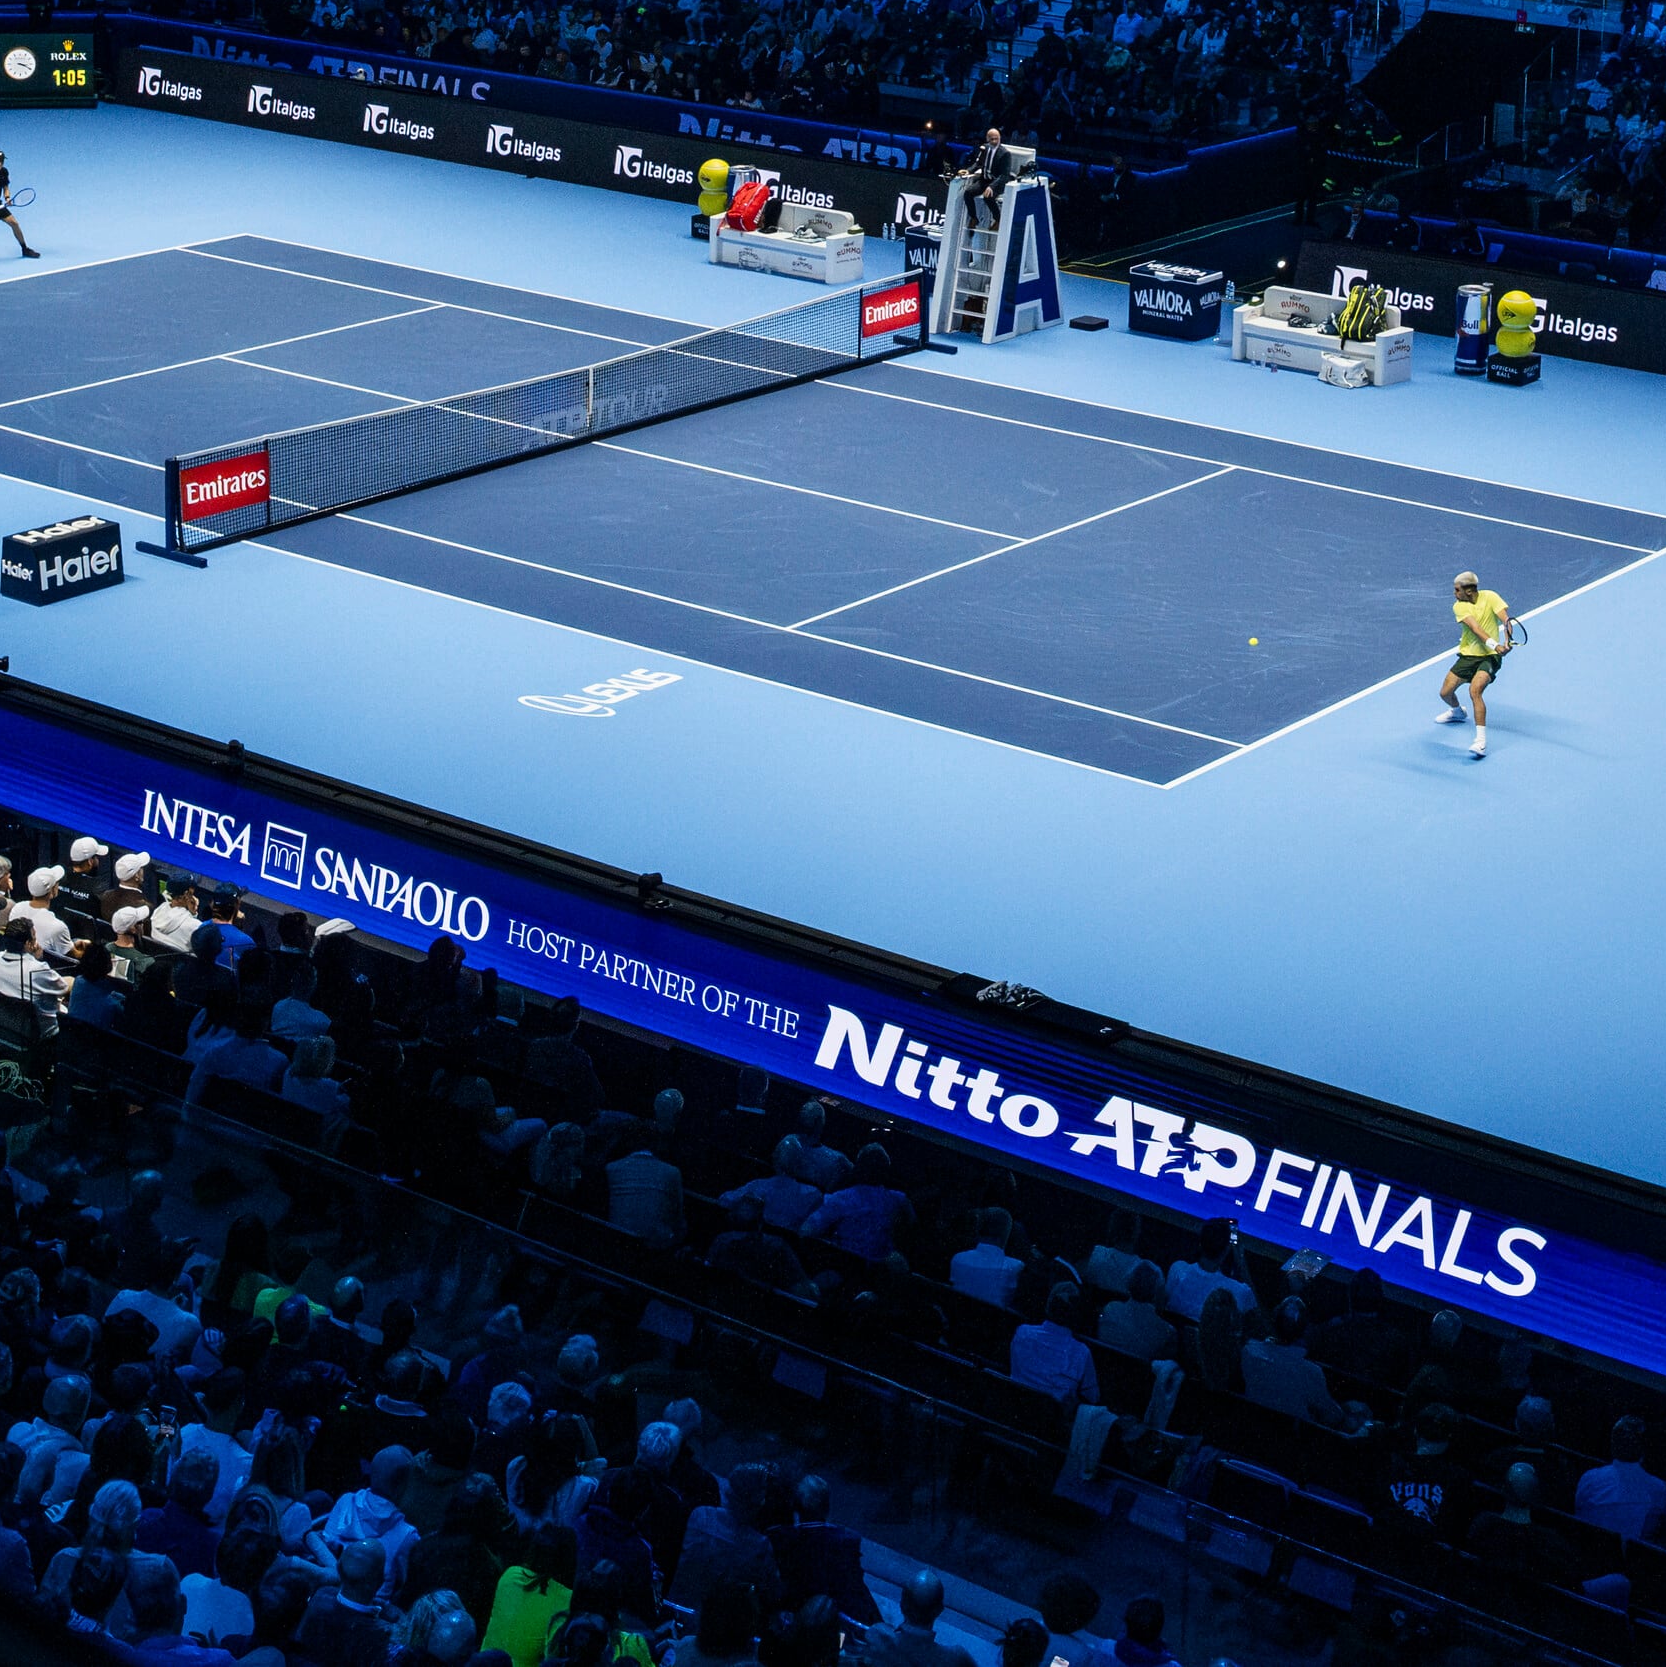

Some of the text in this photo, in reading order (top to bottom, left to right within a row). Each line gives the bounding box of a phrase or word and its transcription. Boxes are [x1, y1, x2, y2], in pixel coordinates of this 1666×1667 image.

[50, 52, 87, 62] ROLEX
[52, 69, 87, 88] 1:05
[160, 75, 202, 102] Italgas
[271, 95, 316, 122] Italgas
[388, 115, 434, 142] Italgas
[514, 135, 561, 164] Italgas
[643, 156, 694, 186] Italgas
[780, 184, 835, 209] Italgas
[864, 296, 918, 326] Emirates
[1134, 287, 1194, 318] VALMORA
[1281, 299, 1311, 314] RUMMO
[1461, 319, 1480, 330] Bull
[1545, 312, 1619, 344] Italgas
[1490, 364, 1519, 375] OFFICIAL
[1495, 371, 1512, 379] BALL
[185, 468, 267, 505] Emirates
[12, 516, 107, 545] Haier
[1, 557, 35, 582] Haier
[39, 543, 121, 592] Haier
[140, 788, 1549, 1300] INTESA SANPAOLO HOST PARTNER OF THE Nitto ATP FINALS
